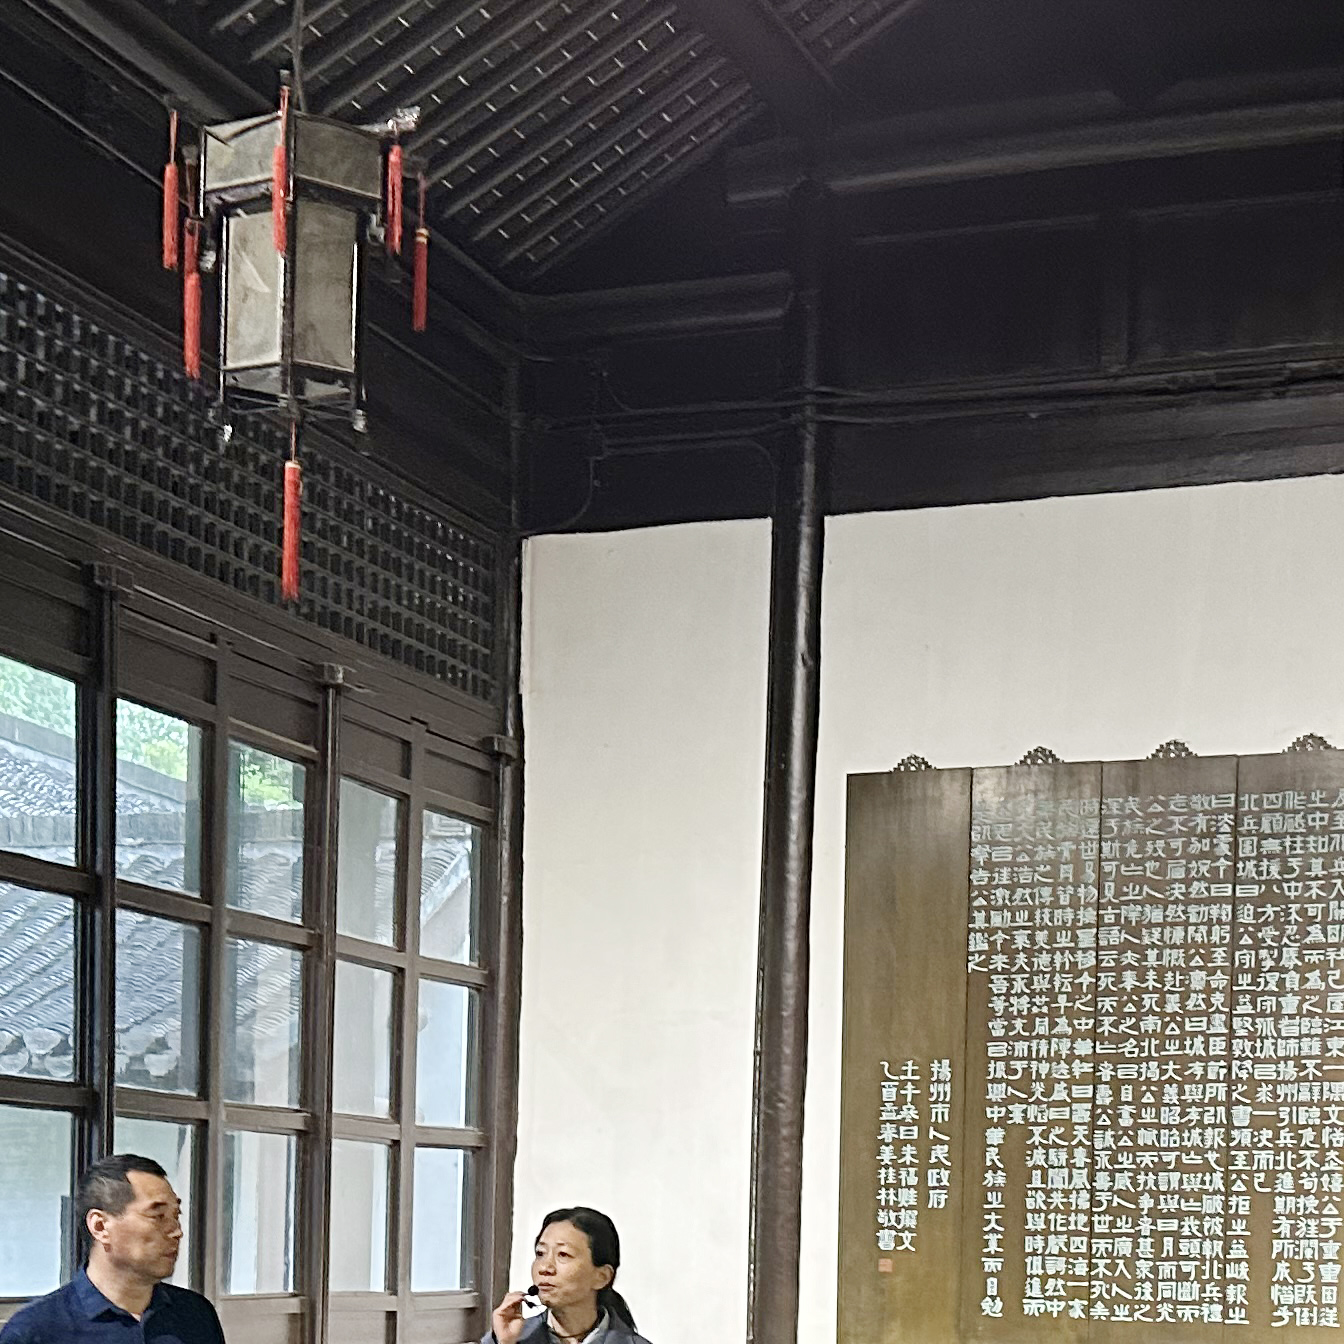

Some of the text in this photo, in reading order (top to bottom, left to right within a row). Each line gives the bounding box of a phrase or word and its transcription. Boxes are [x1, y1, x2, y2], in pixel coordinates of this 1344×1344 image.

[926, 1058, 953, 1209] 揚州市人民政府
